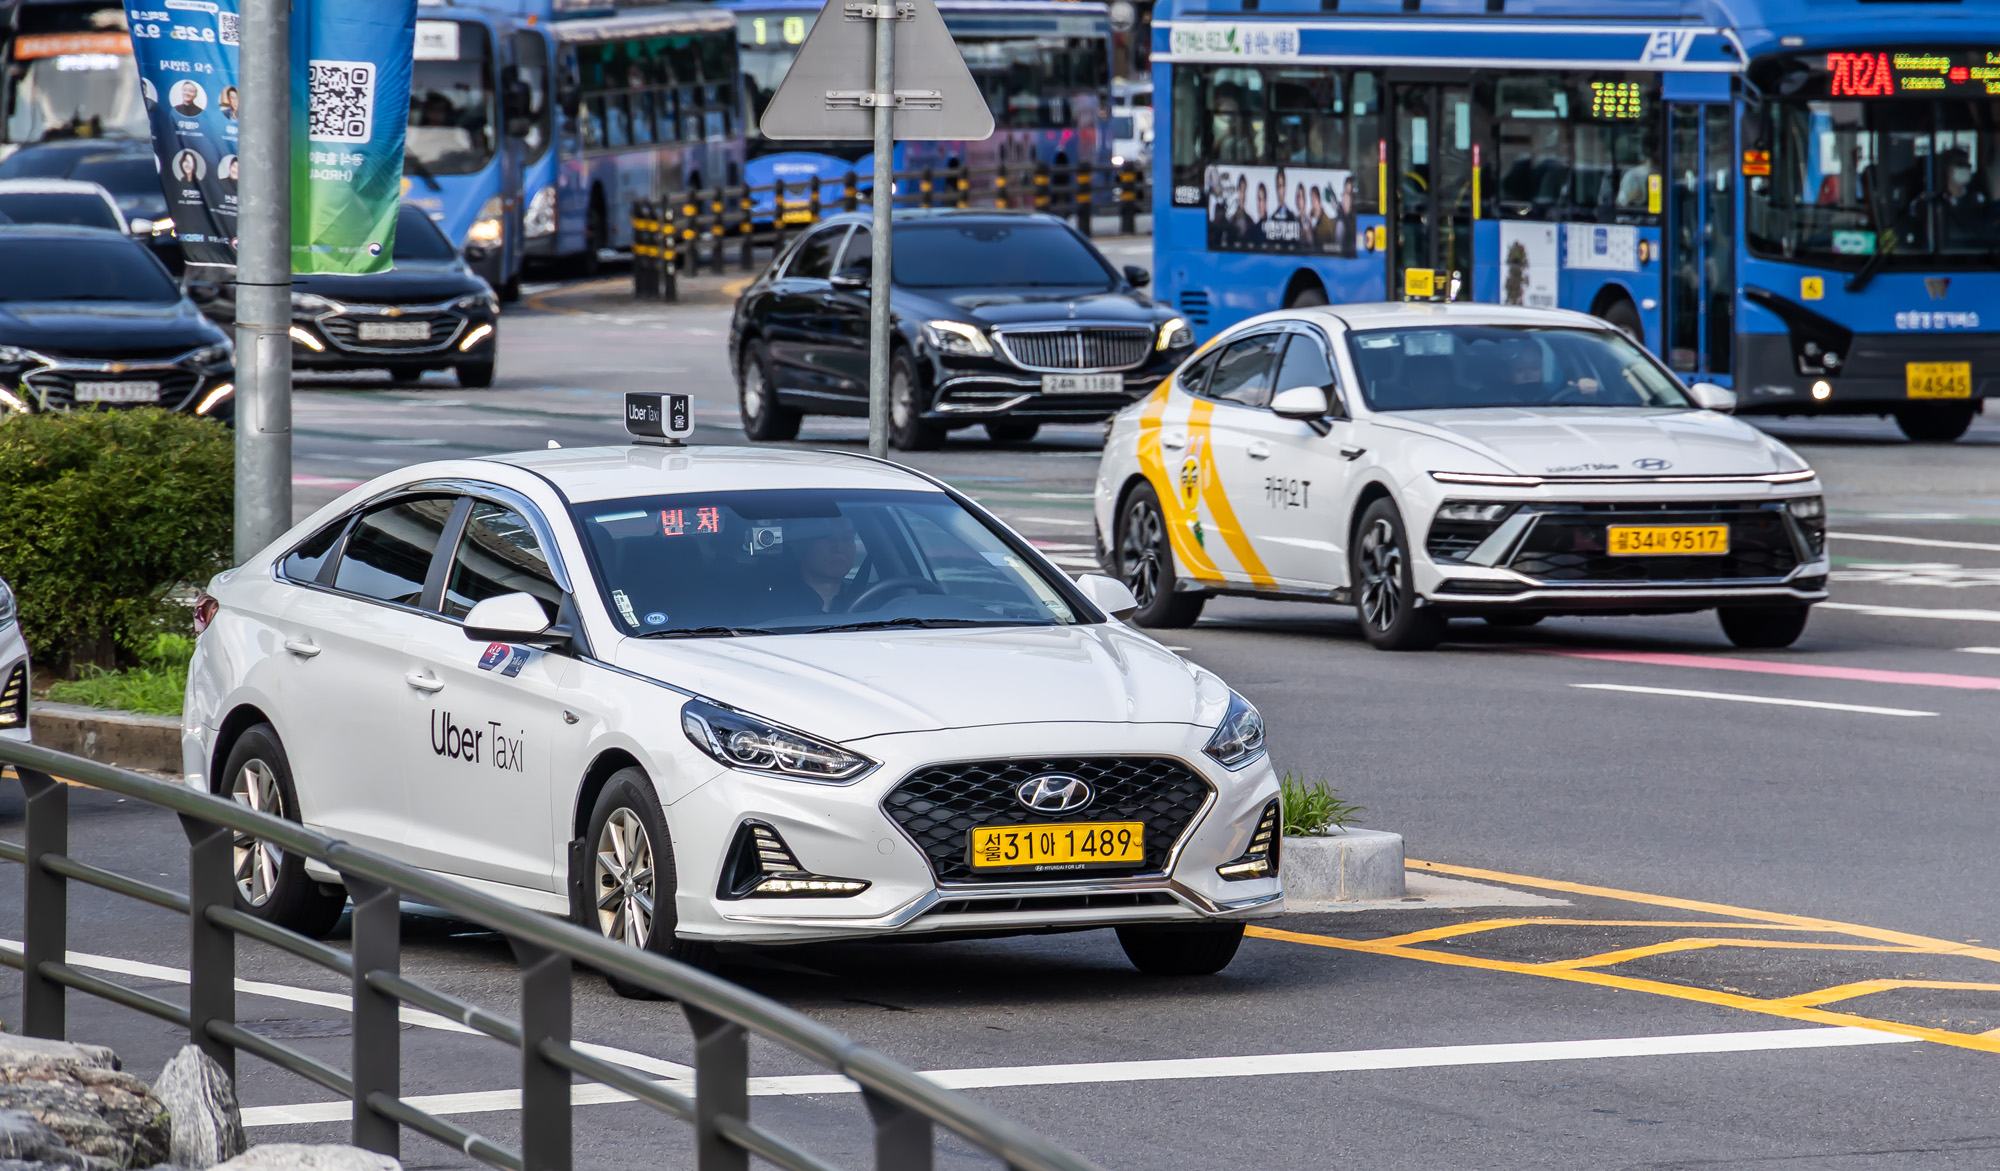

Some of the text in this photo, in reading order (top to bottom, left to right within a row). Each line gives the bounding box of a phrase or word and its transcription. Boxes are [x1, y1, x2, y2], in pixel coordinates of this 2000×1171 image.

[1827, 53, 1894, 96] 702A
[1923, 377, 1967, 393] 4545
[629, 403, 659, 421] Uber Taxi
[674, 400, 685, 429] 서울
[1671, 530, 1719, 549] 9517
[431, 709, 524, 773] Uber Taxi
[1065, 829, 1131, 858] 1489
